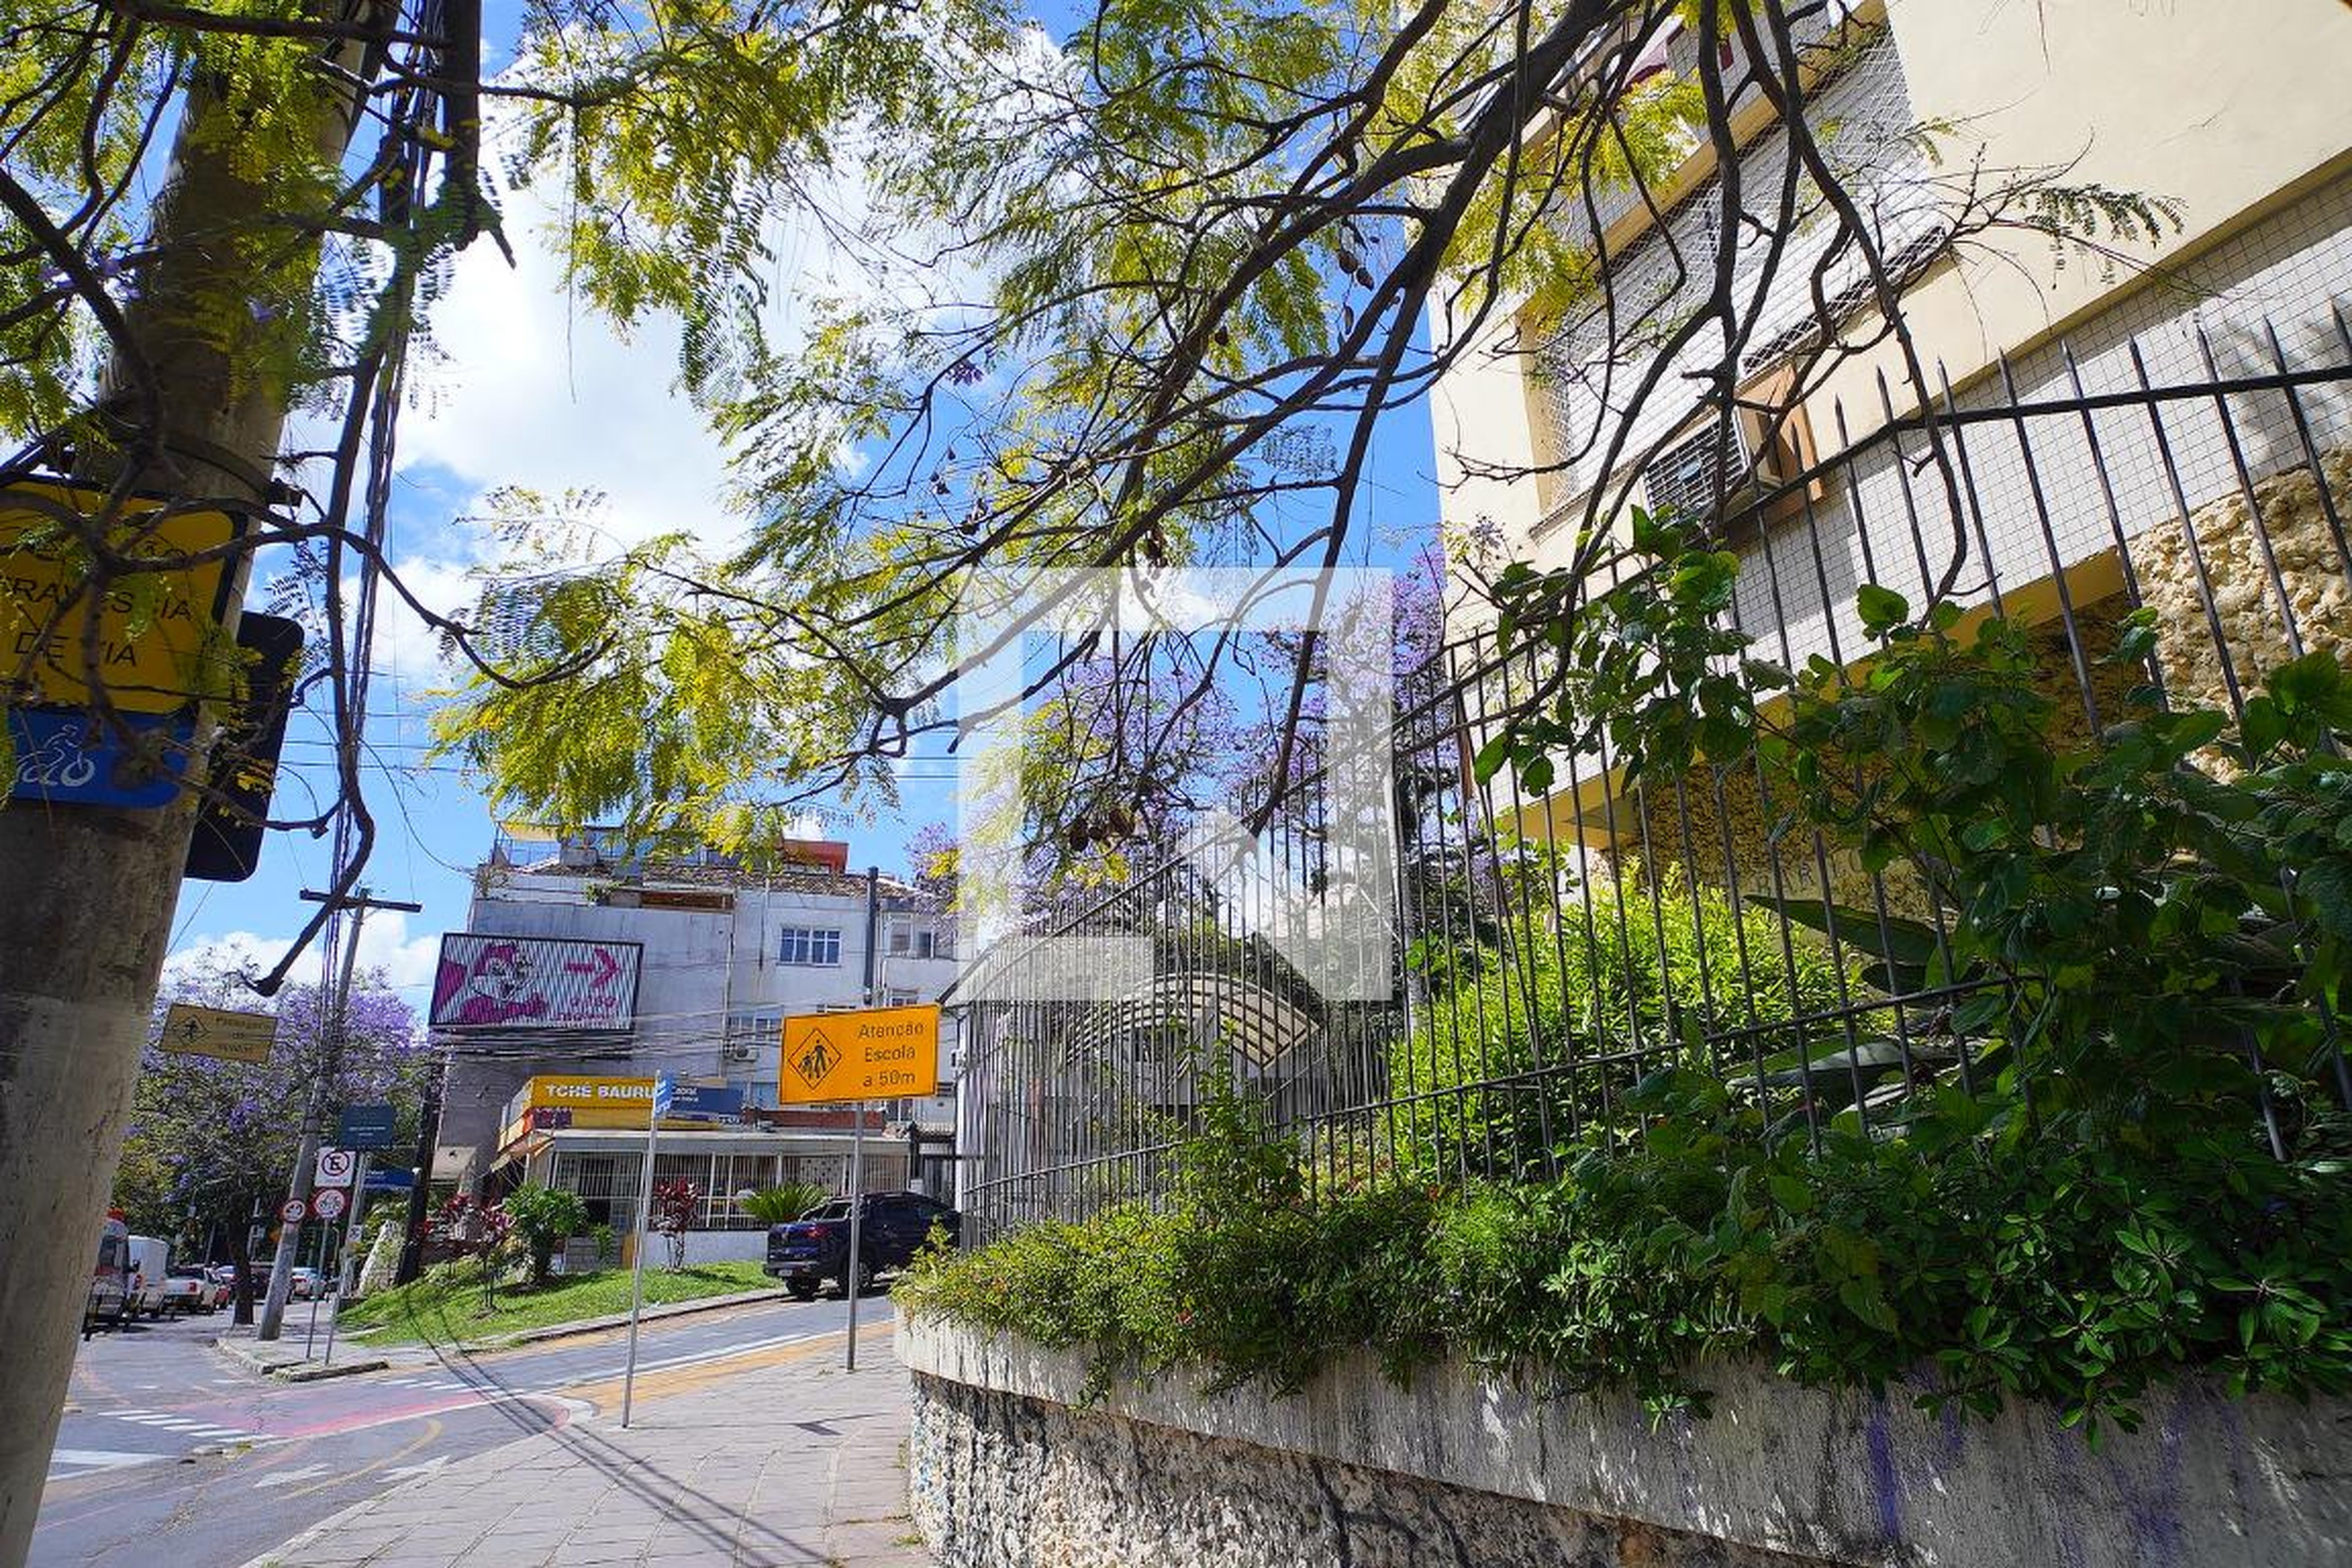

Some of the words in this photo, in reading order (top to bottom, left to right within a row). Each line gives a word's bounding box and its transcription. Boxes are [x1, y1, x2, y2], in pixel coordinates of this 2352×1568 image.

[89, 639, 137, 666] IA
[865, 1045, 916, 1062] Escola
[862, 1075, 873, 1087] a
[879, 1069, 916, 1087] 50m
[598, 1085, 654, 1098] BAURU
